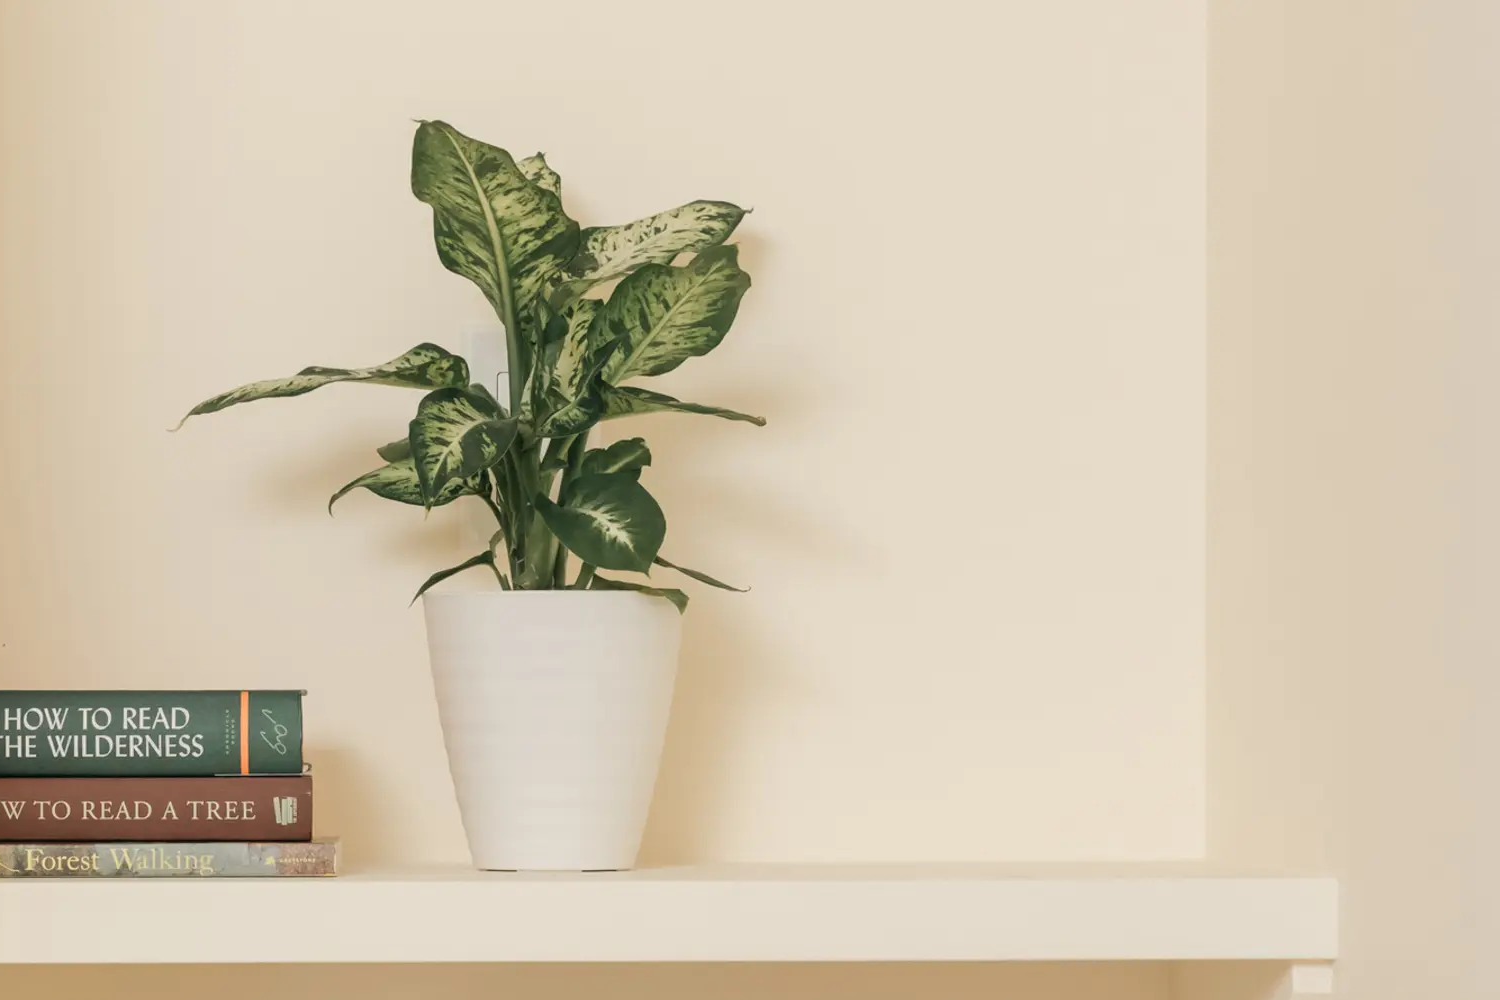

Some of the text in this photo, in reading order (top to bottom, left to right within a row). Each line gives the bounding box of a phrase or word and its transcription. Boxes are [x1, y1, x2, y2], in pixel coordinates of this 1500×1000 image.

[3, 706, 191, 730] HOW TO READ
[47, 733, 205, 758] WILDERNESS
[33, 800, 72, 821] TO
[81, 800, 153, 820] READ
[161, 800, 180, 820] A
[186, 800, 257, 820] TREE
[24, 847, 215, 875] Forest Walking
